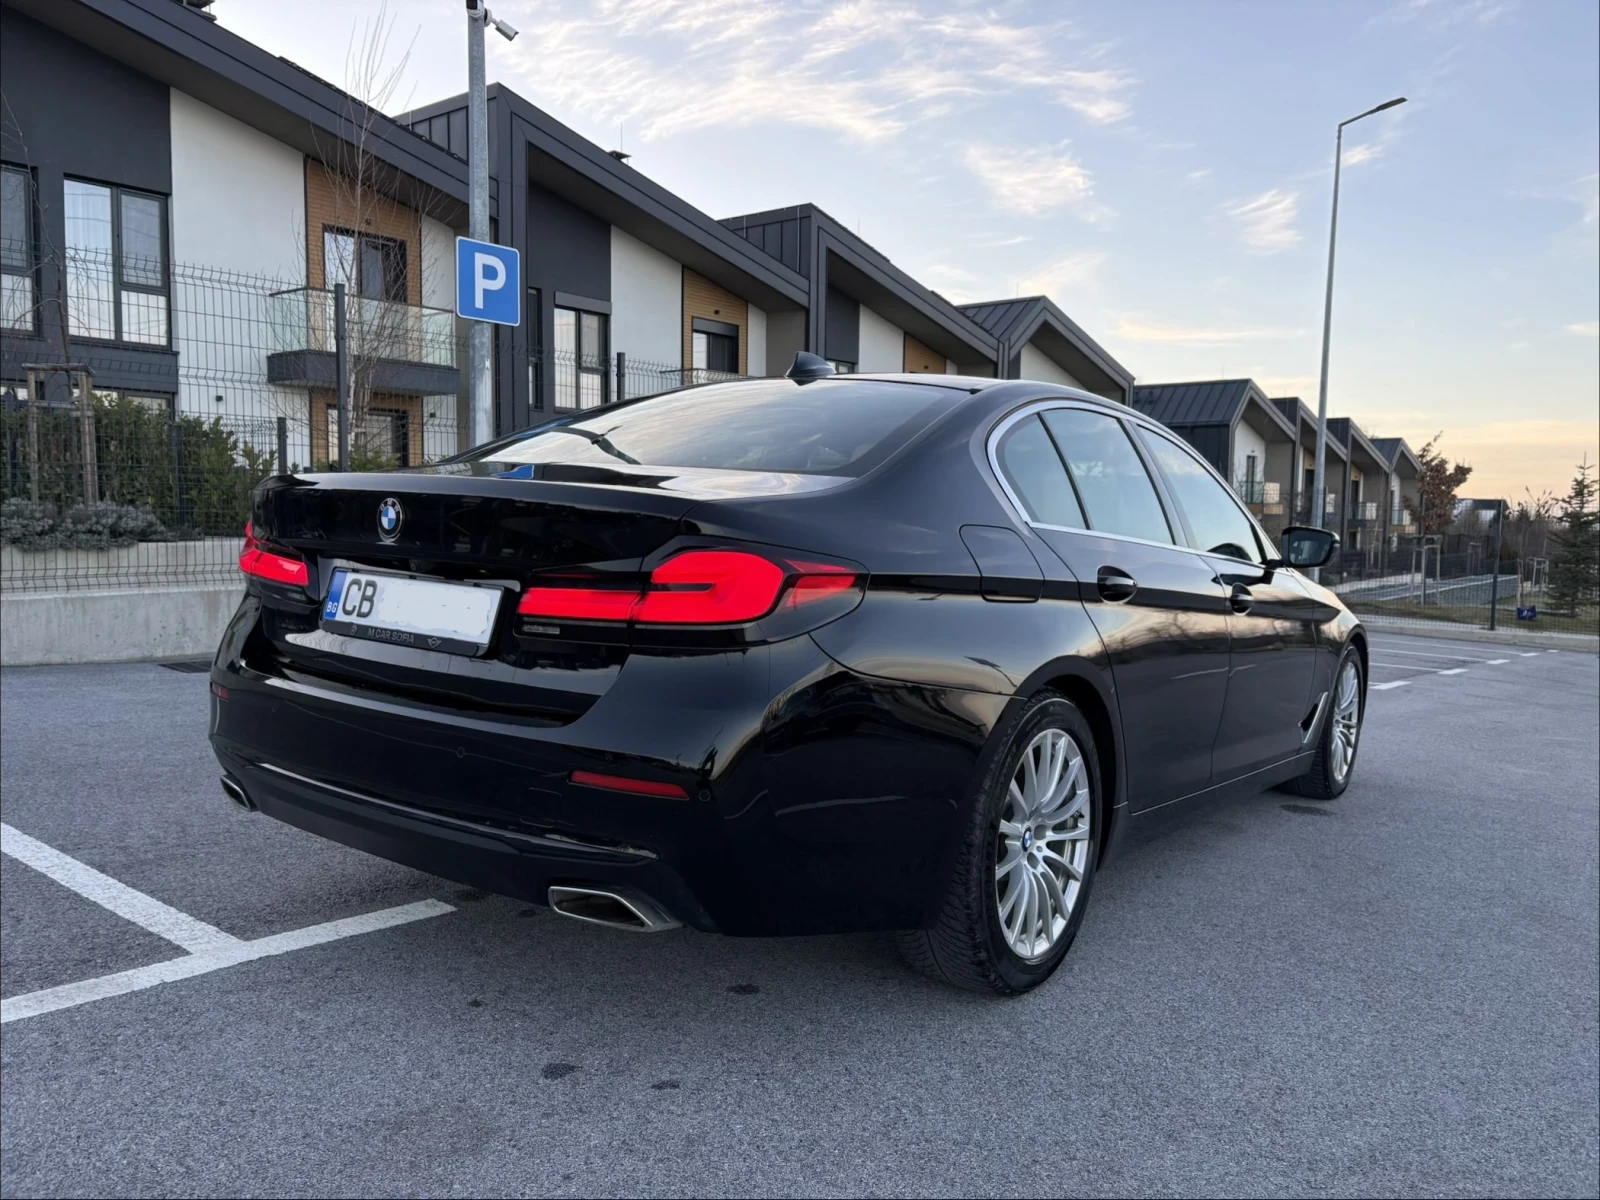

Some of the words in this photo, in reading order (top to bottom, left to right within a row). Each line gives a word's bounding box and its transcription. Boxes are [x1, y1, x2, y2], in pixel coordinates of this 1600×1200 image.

[474, 252, 506, 310] P
[326, 601, 338, 613] BG
[342, 578, 377, 618] CB
[367, 628, 374, 637] M
[375, 629, 391, 639] CAR
[391, 631, 415, 644] SOFIA
